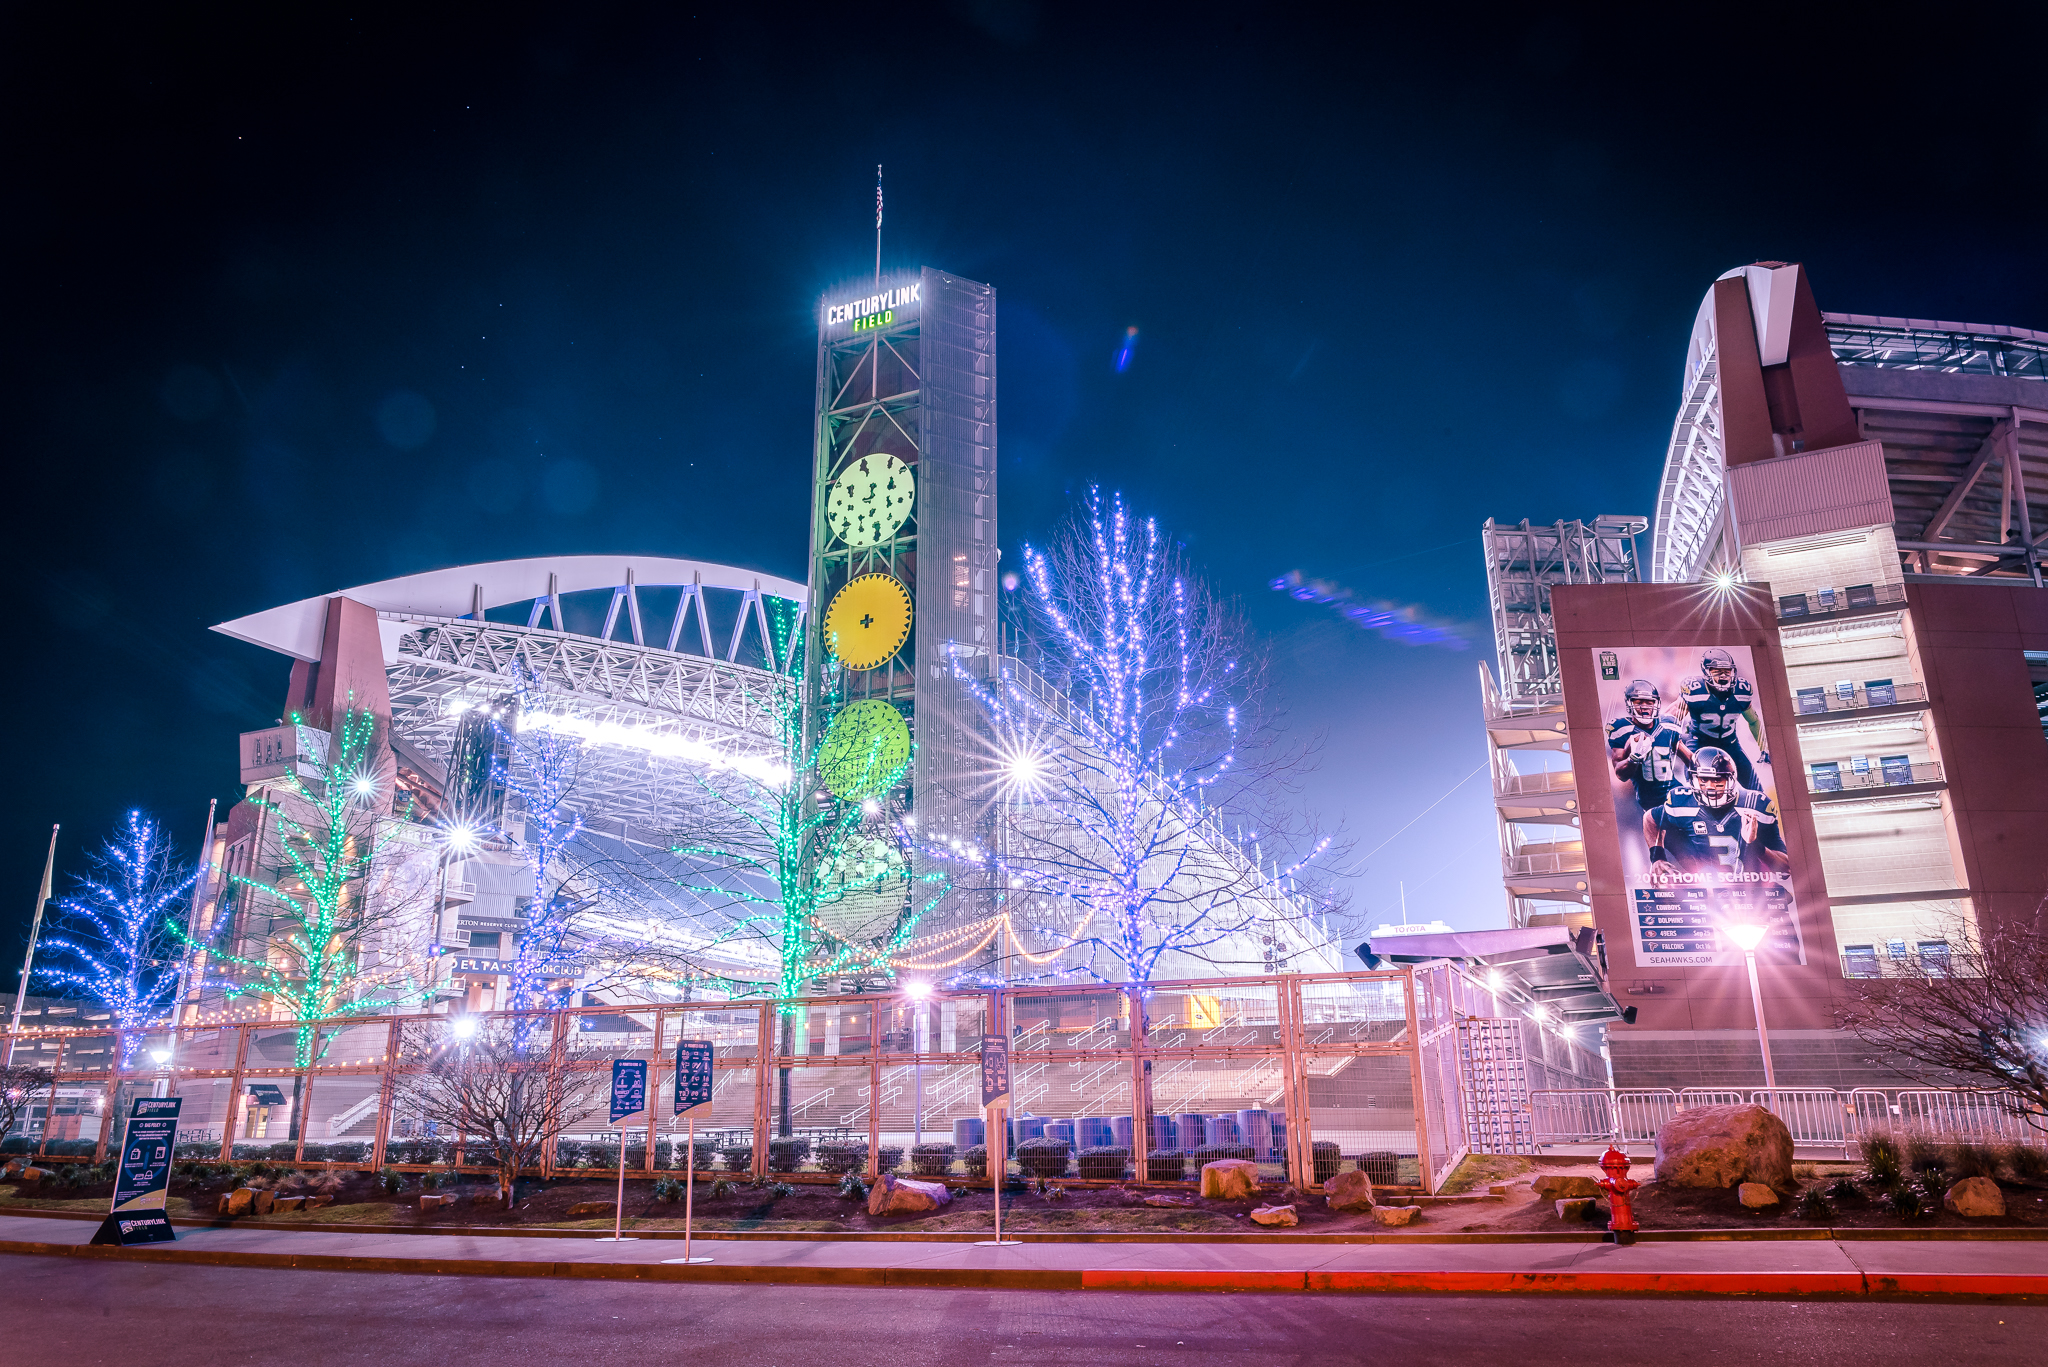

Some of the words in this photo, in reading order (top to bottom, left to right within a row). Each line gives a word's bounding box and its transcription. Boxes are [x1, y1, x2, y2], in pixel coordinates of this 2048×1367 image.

[828, 283, 920, 325] CENTURYLINK
[854, 310, 893, 332] FIELD
[1605, 667, 1614, 675] 12
[1699, 713, 1739, 739] 29
[1642, 746, 1674, 782] 16
[1708, 835, 1744, 874] 3
[1634, 873, 1668, 883] 2016
[1673, 872, 1713, 883] HOME
[1717, 871, 1783, 882] SCHEDULE
[1687, 891, 1698, 899] Aug
[1689, 904, 1700, 912] Aug
[1691, 917, 1701, 925] Sep
[1692, 930, 1703, 938] Sep
[1650, 956, 1713, 964] SEAHAWKS.COM
[553, 965, 583, 976] CLUB
[130, 1218, 167, 1227] CENTURYLINK
